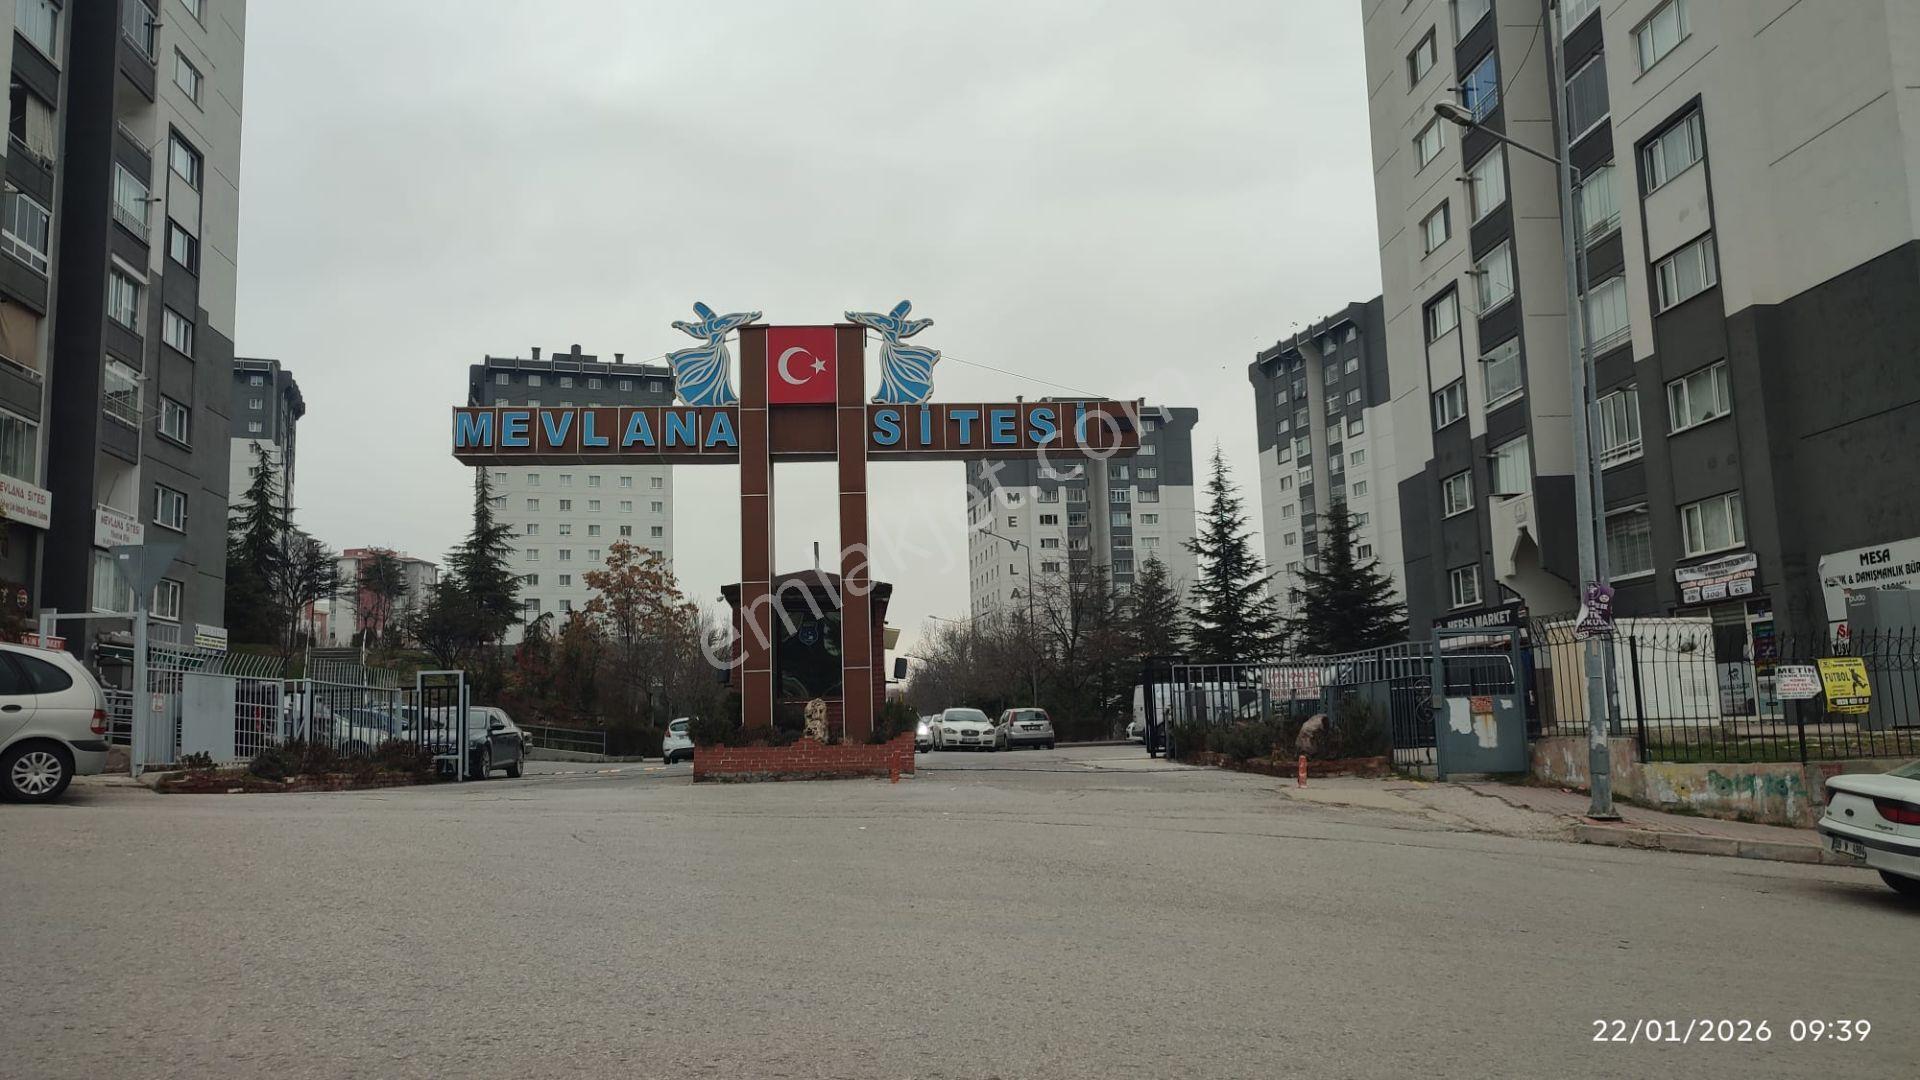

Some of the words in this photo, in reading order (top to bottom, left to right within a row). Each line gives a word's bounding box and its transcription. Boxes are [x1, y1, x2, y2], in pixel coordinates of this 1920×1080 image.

[455, 411, 738, 447] MEVLANA
[873, 402, 1087, 445] SİTESİ
[1860, 549, 1890, 566] MESA
[1855, 565, 1904, 583] DANIŞMANLIK
[1475, 610, 1510, 627] MARKET
[1825, 671, 1851, 683] FUTBOL
